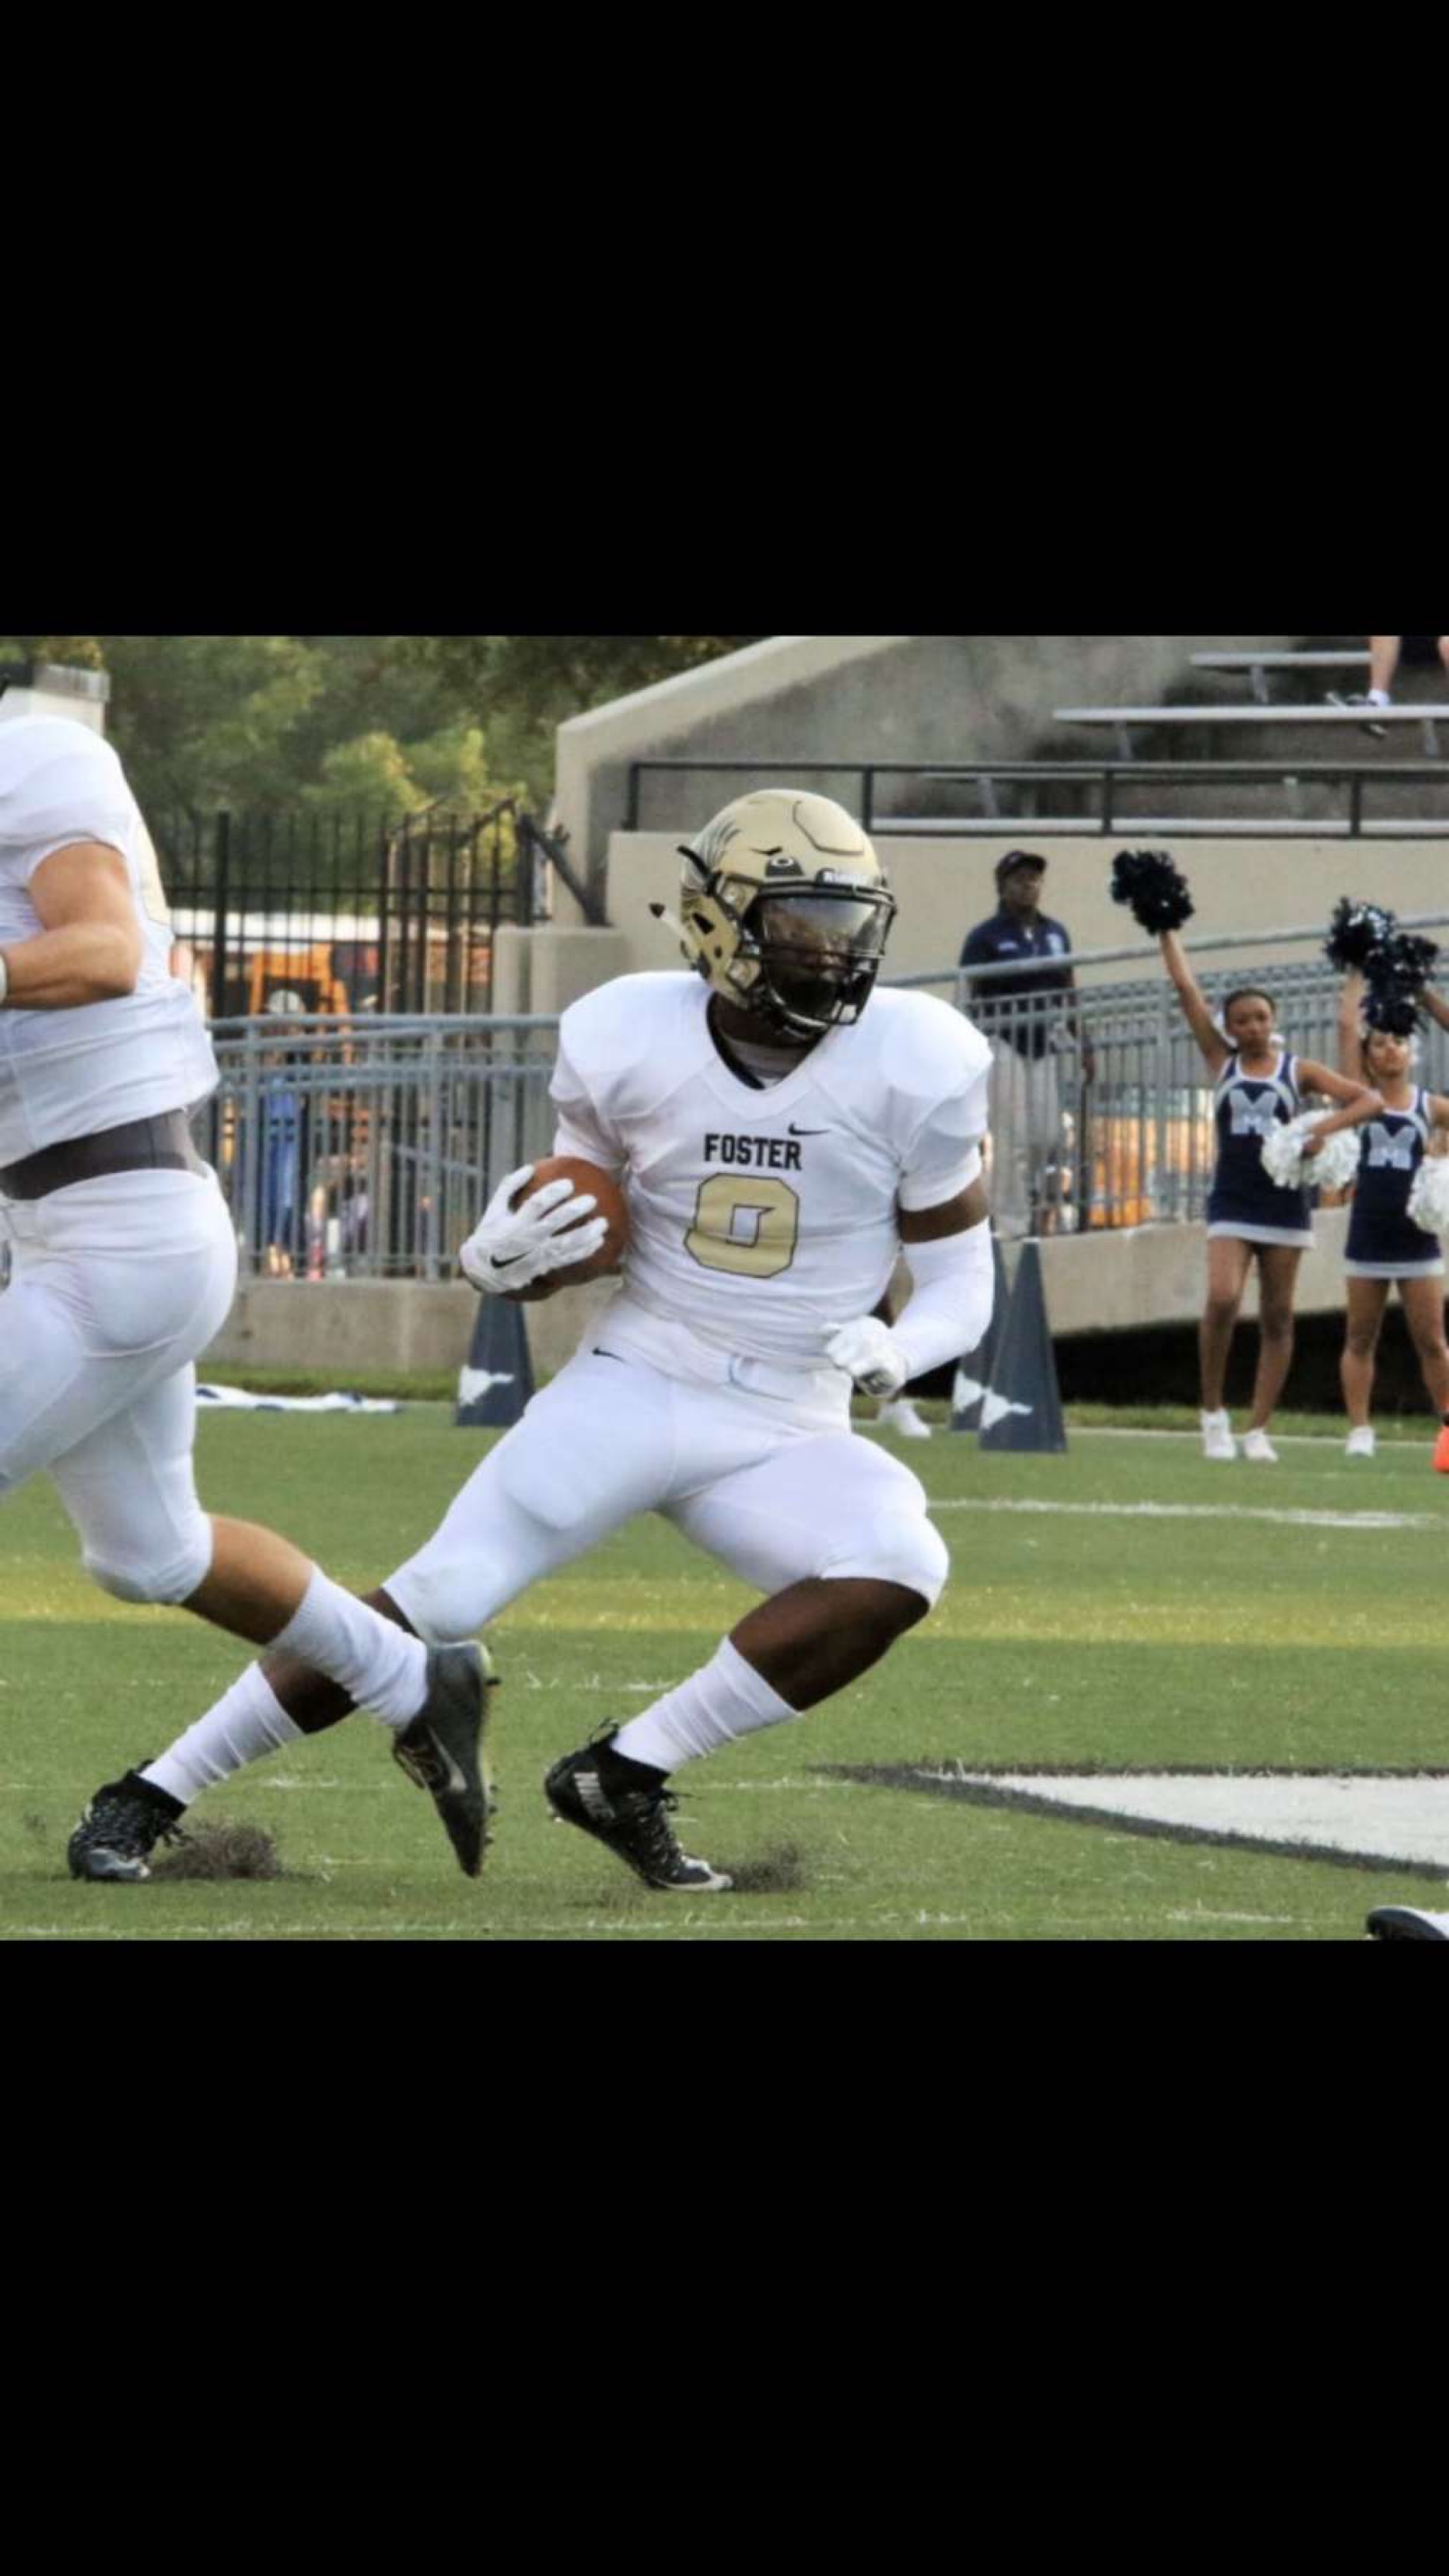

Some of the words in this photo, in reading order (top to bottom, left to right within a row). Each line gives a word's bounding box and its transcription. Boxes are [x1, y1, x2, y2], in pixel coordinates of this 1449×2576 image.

[1229, 1088, 1277, 1136] M
[704, 1133, 802, 1171] FOSTER
[1367, 1122, 1416, 1170] M
